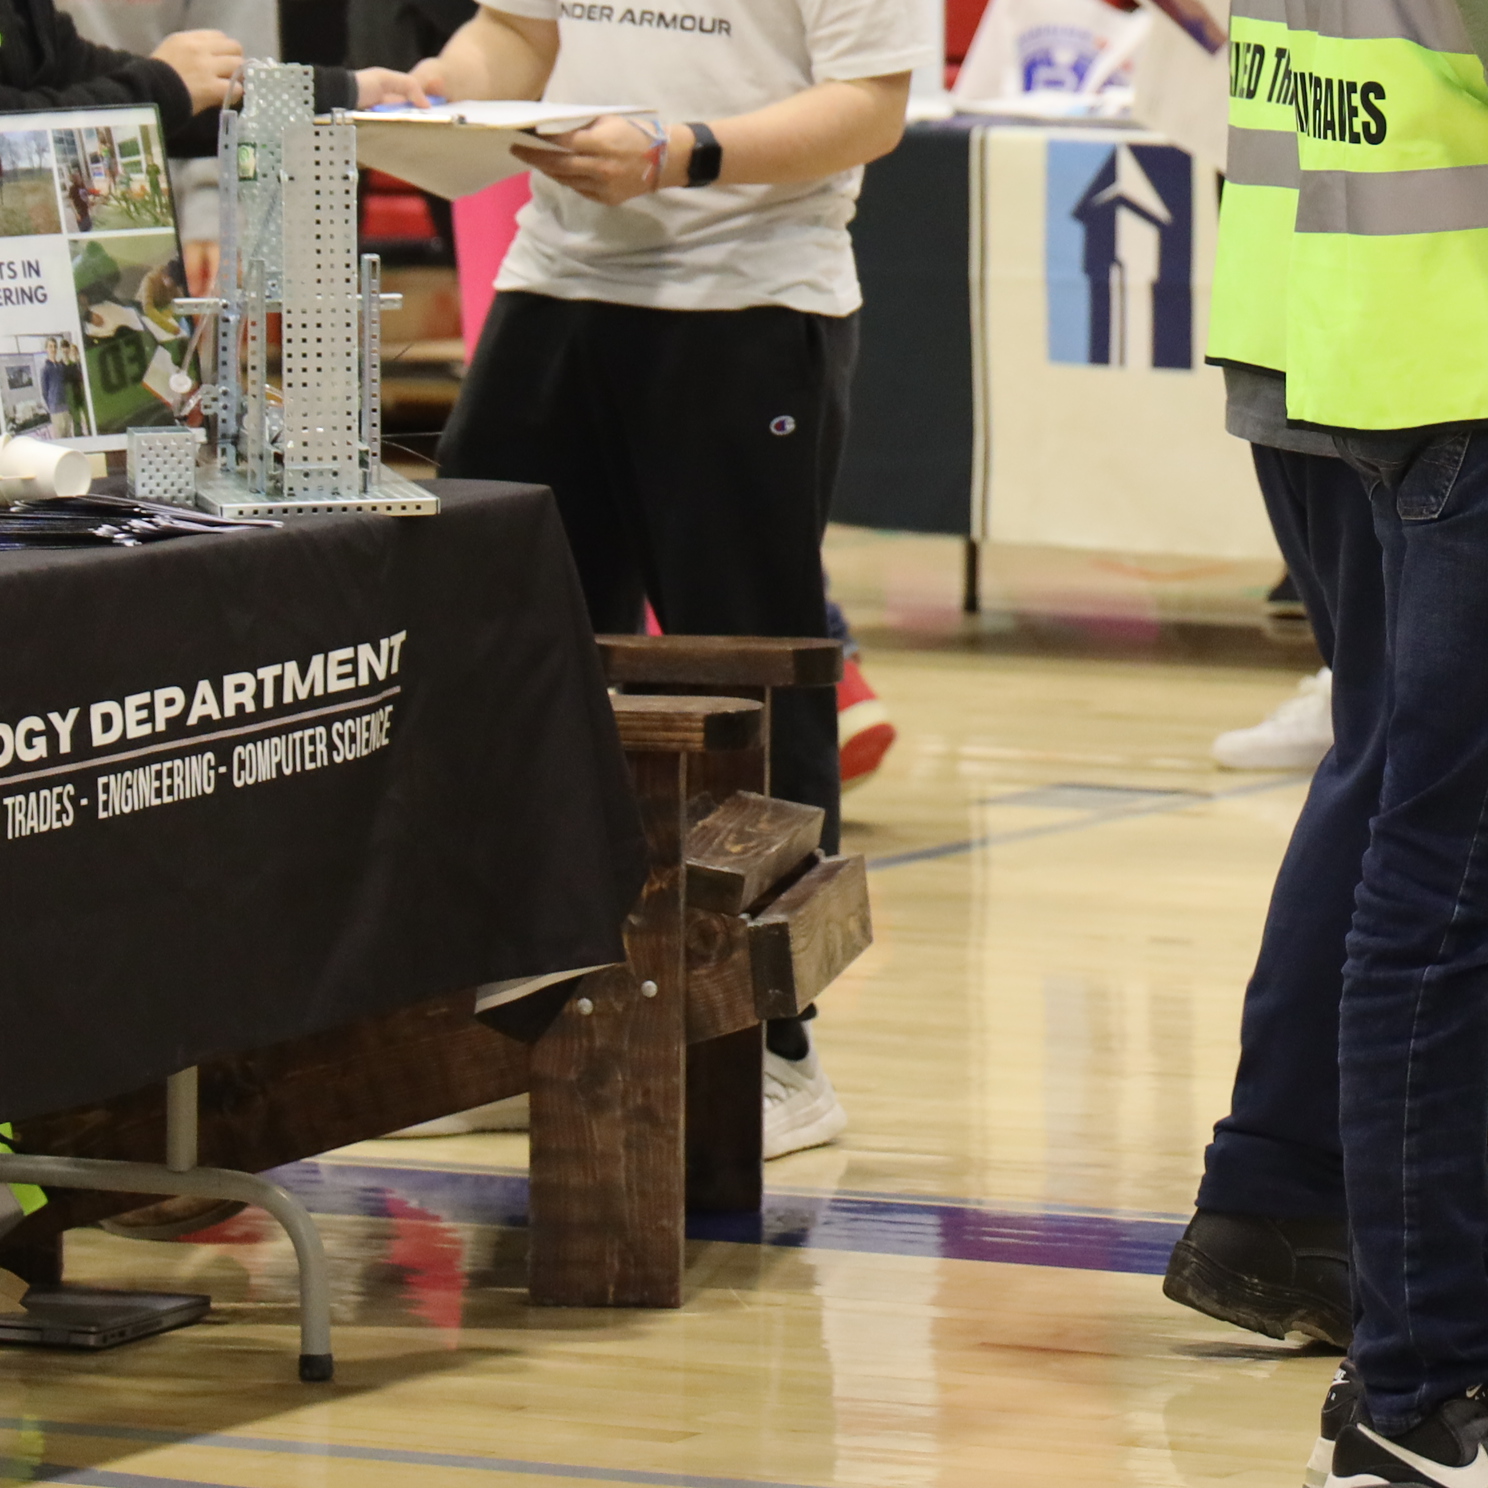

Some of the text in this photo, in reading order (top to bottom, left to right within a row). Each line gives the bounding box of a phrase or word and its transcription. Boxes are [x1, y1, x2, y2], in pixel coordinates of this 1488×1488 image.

[561, 2, 733, 37] NDER ARMOUR
[22, 259, 42, 279] IN
[90, 630, 407, 746] DEPARTMENT
[3, 783, 75, 841] TRADES
[97, 751, 216, 820] ENGINEERING
[232, 732, 328, 788] COMPUTER
[332, 705, 394, 763] SCIENCE
